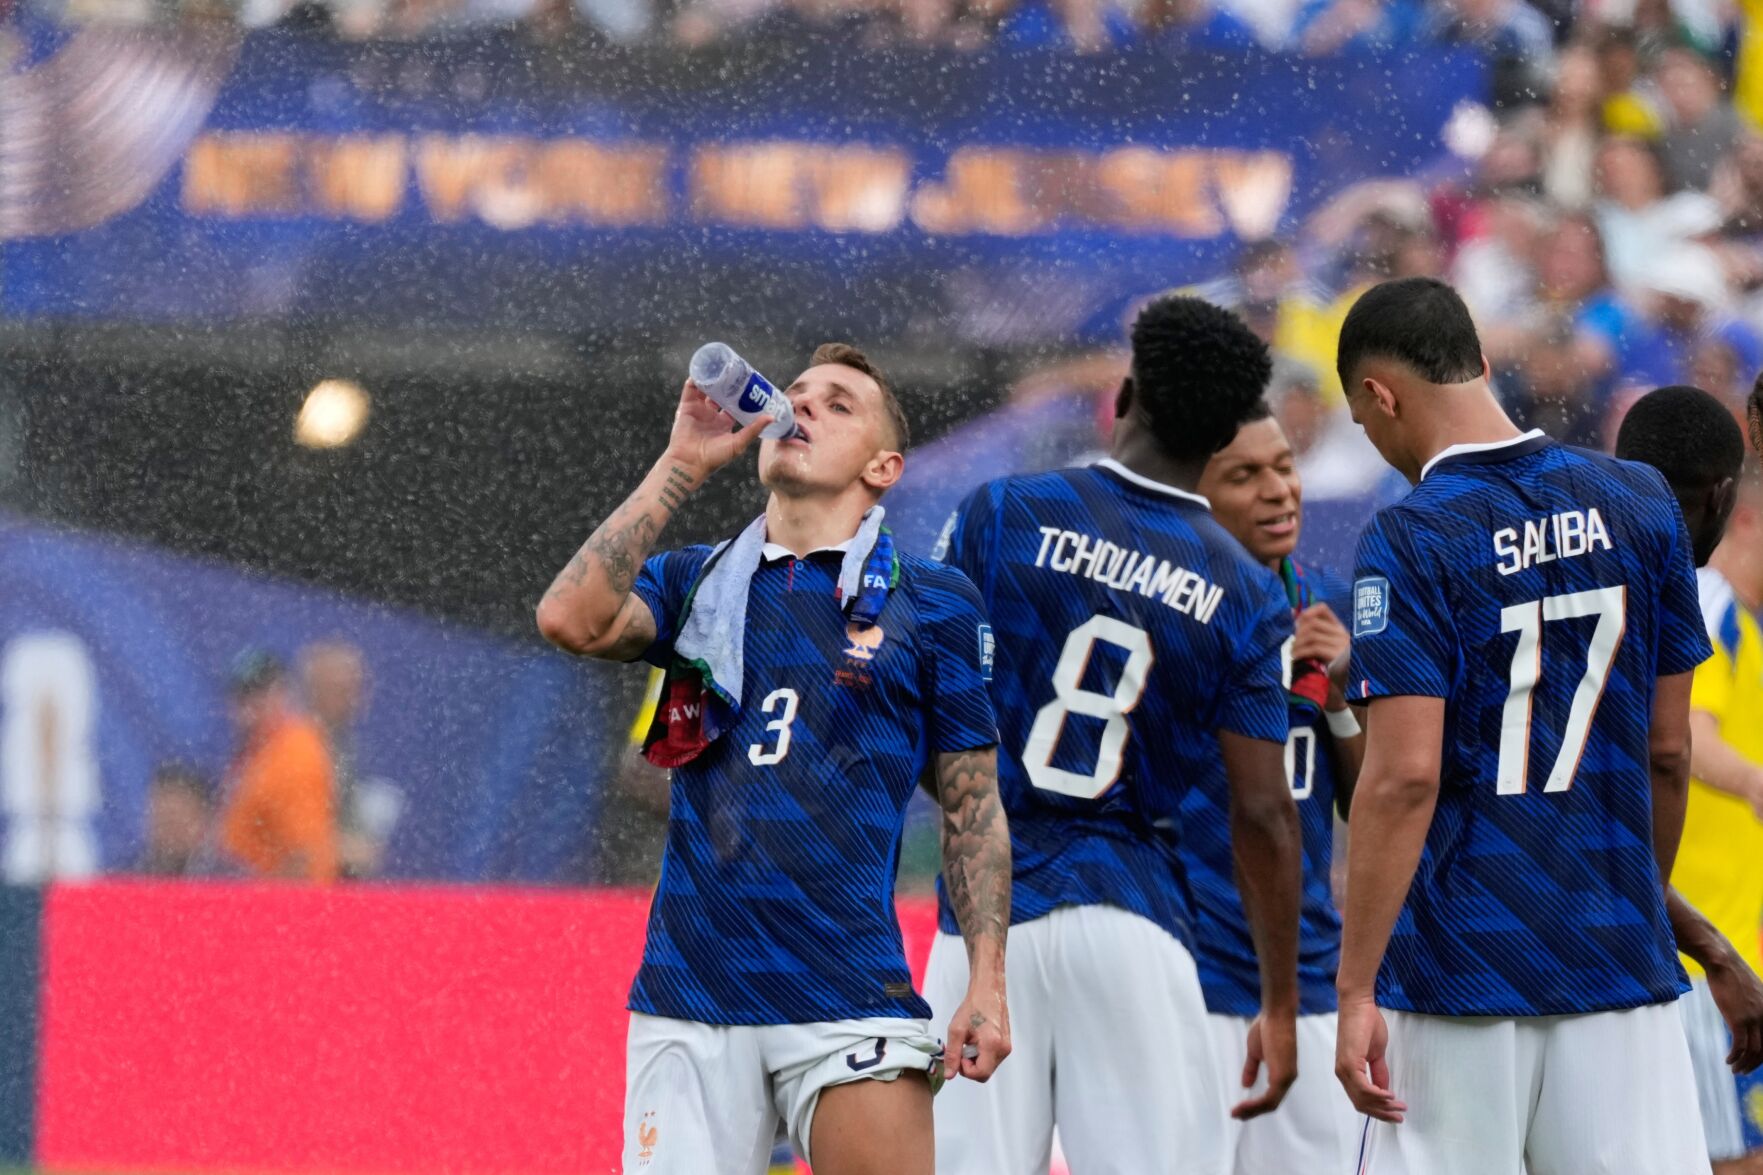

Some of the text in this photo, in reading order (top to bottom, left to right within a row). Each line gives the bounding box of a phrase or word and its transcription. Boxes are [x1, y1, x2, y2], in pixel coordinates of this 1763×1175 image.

[1034, 526, 1225, 625] TCHOUAMENI
[1493, 507, 1613, 577] SALIBA
[748, 687, 800, 766] 3
[1021, 614, 1155, 799] 8
[1496, 585, 1627, 796] 17
